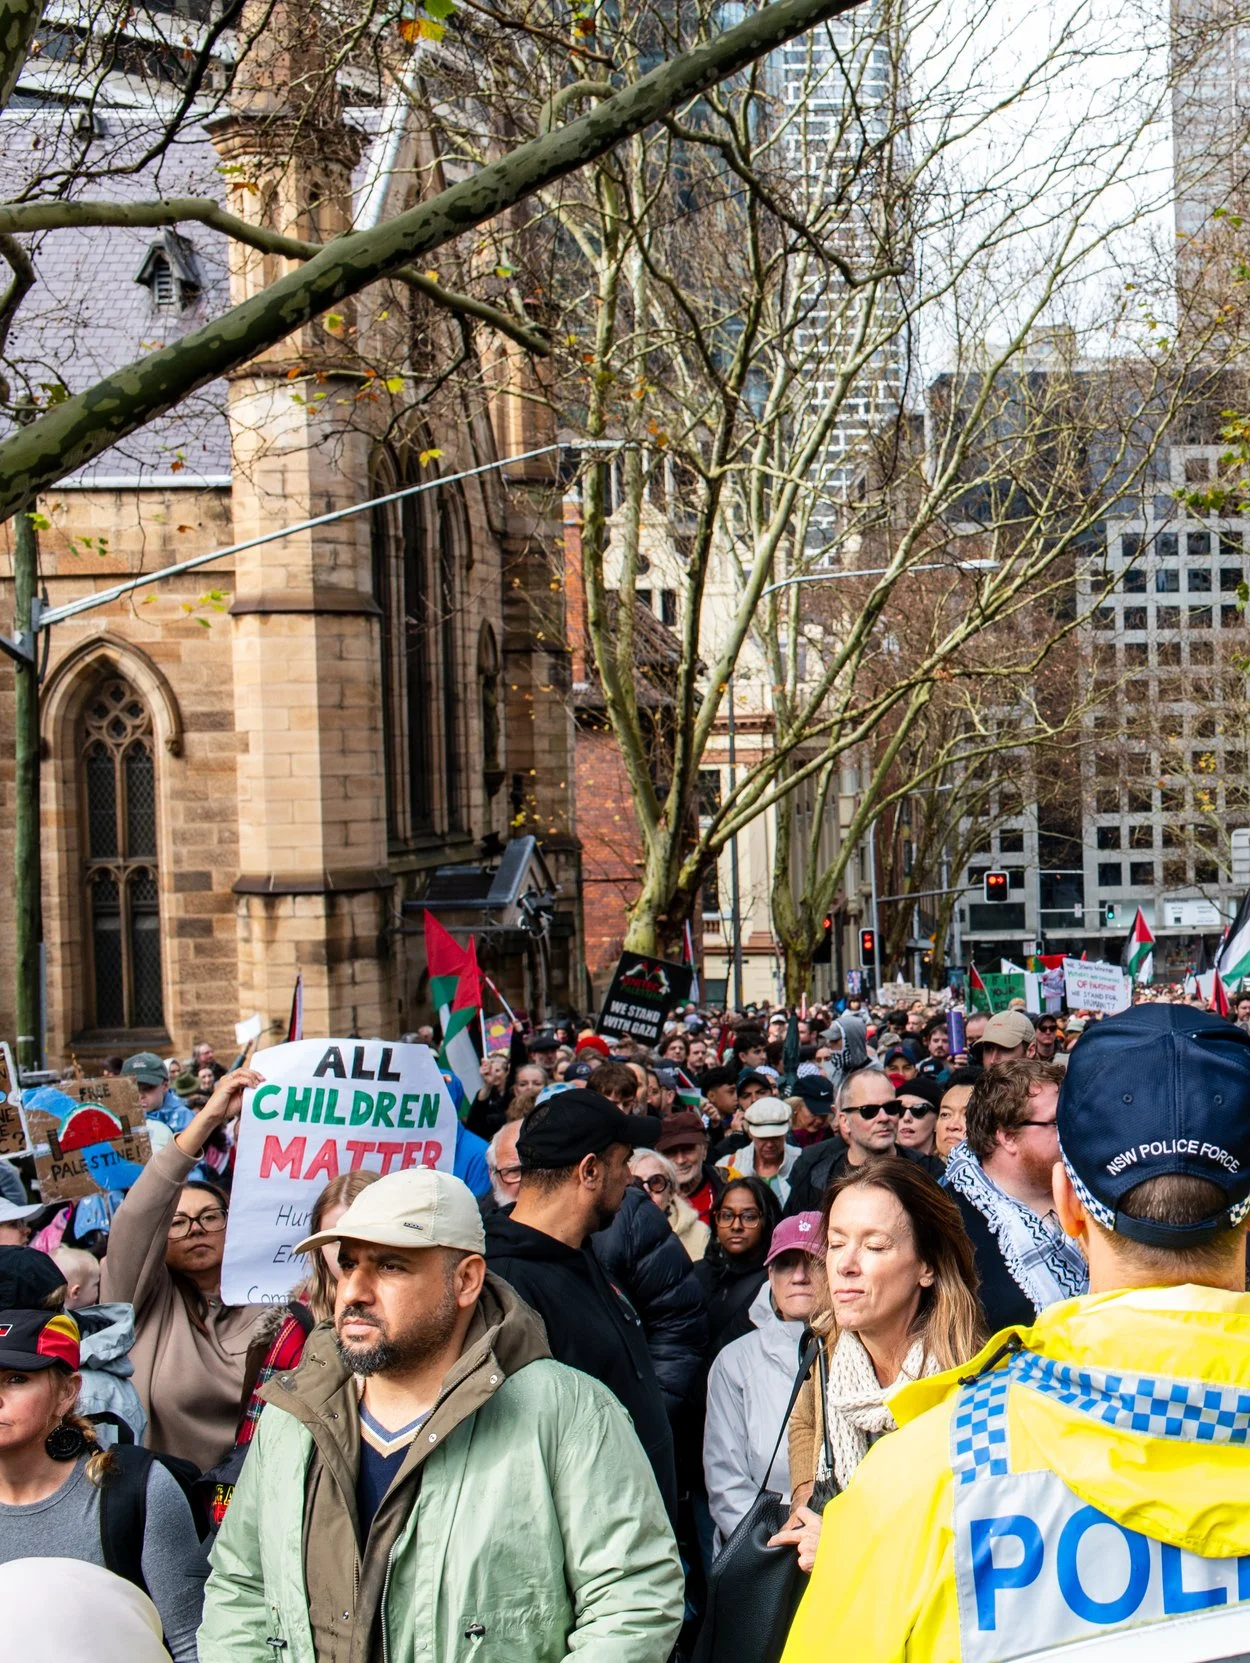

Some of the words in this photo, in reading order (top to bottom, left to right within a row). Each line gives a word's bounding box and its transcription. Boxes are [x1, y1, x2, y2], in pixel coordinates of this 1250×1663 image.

[1077, 980, 1087, 989] OF
[603, 1014, 631, 1032] WITH
[630, 1021, 658, 1039] GAZA
[610, 1000, 628, 1015] WE
[627, 1004, 661, 1023] STAND
[312, 1046, 402, 1082] ALL
[79, 1083, 111, 1101] FREE
[252, 1084, 441, 1128] CHILDREN
[51, 1145, 142, 1182] PALESTINE!
[259, 1135, 443, 1182] MATTER
[1106, 1147, 1138, 1176] NSW
[1138, 1139, 1200, 1159] POLICE
[1199, 1142, 1241, 1174] FORCE
